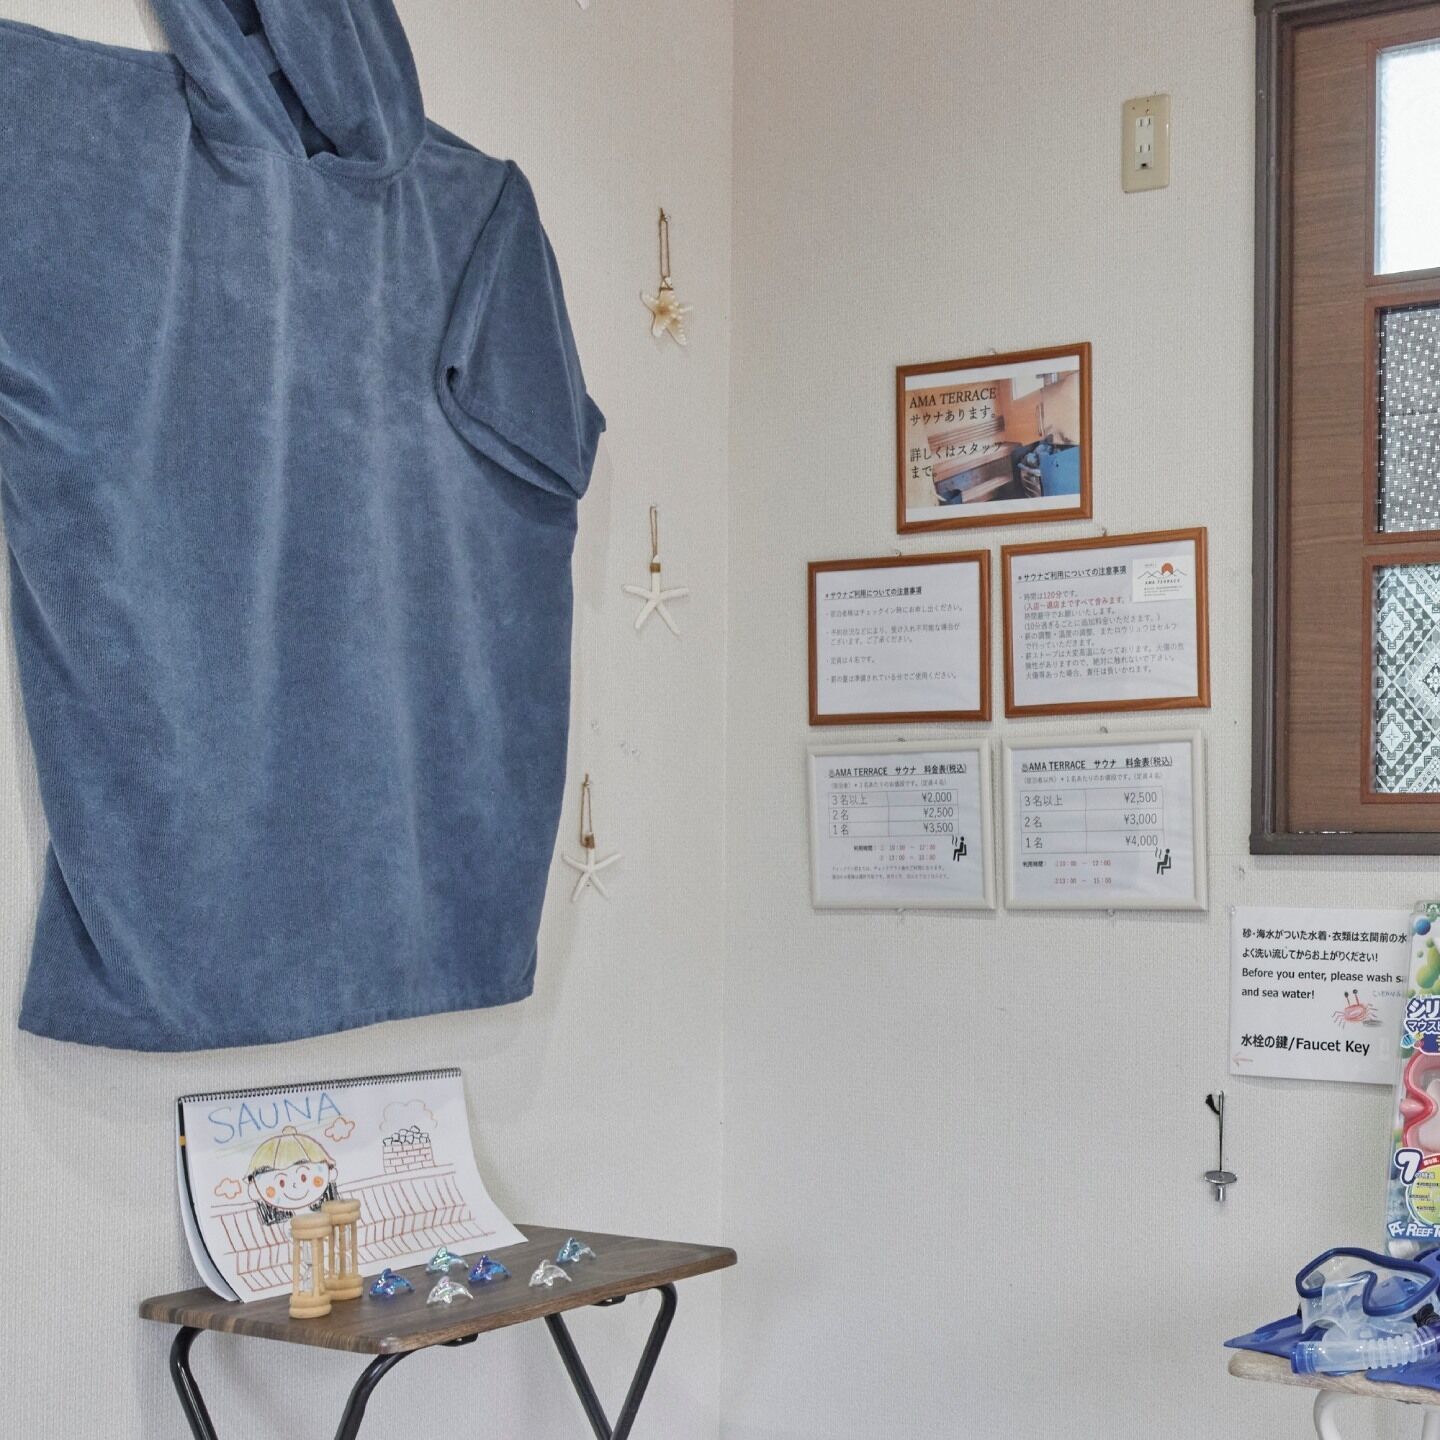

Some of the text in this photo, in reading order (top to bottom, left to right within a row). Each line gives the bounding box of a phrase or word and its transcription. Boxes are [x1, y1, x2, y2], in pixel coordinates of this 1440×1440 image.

[910, 387, 997, 408] AMA TERRACE
[910, 405, 995, 426] サウナあります。
[910, 441, 1004, 462] 詳しくはスタッフ
[911, 465, 937, 479] まで。
[1028, 757, 1173, 771] AMA TERRACE サウナ 料金表(税込)
[836, 768, 851, 777] AMA
[854, 766, 888, 776] TERRACE
[895, 766, 917, 776] サウナ
[922, 791, 952, 803] ¥2,000
[1124, 792, 1157, 804] ¥2,500
[923, 807, 954, 819] ¥2,500
[923, 822, 954, 833] ¥3,500
[1024, 813, 1157, 828] 2名 ¥3,000
[1026, 835, 1158, 849] 1名 ¥4,000
[1242, 968, 1273, 978] Before
[1276, 970, 1295, 981] you
[1298, 970, 1327, 982] enter,
[1330, 971, 1364, 986] please
[1366, 973, 1393, 983] wash
[1241, 988, 1315, 999] and sea water!
[1345, 1040, 1370, 1056] Key
[208, 1092, 342, 1144] SAUNA
[1396, 1149, 1422, 1184] 7
[1406, 1223, 1433, 1236] REEF
